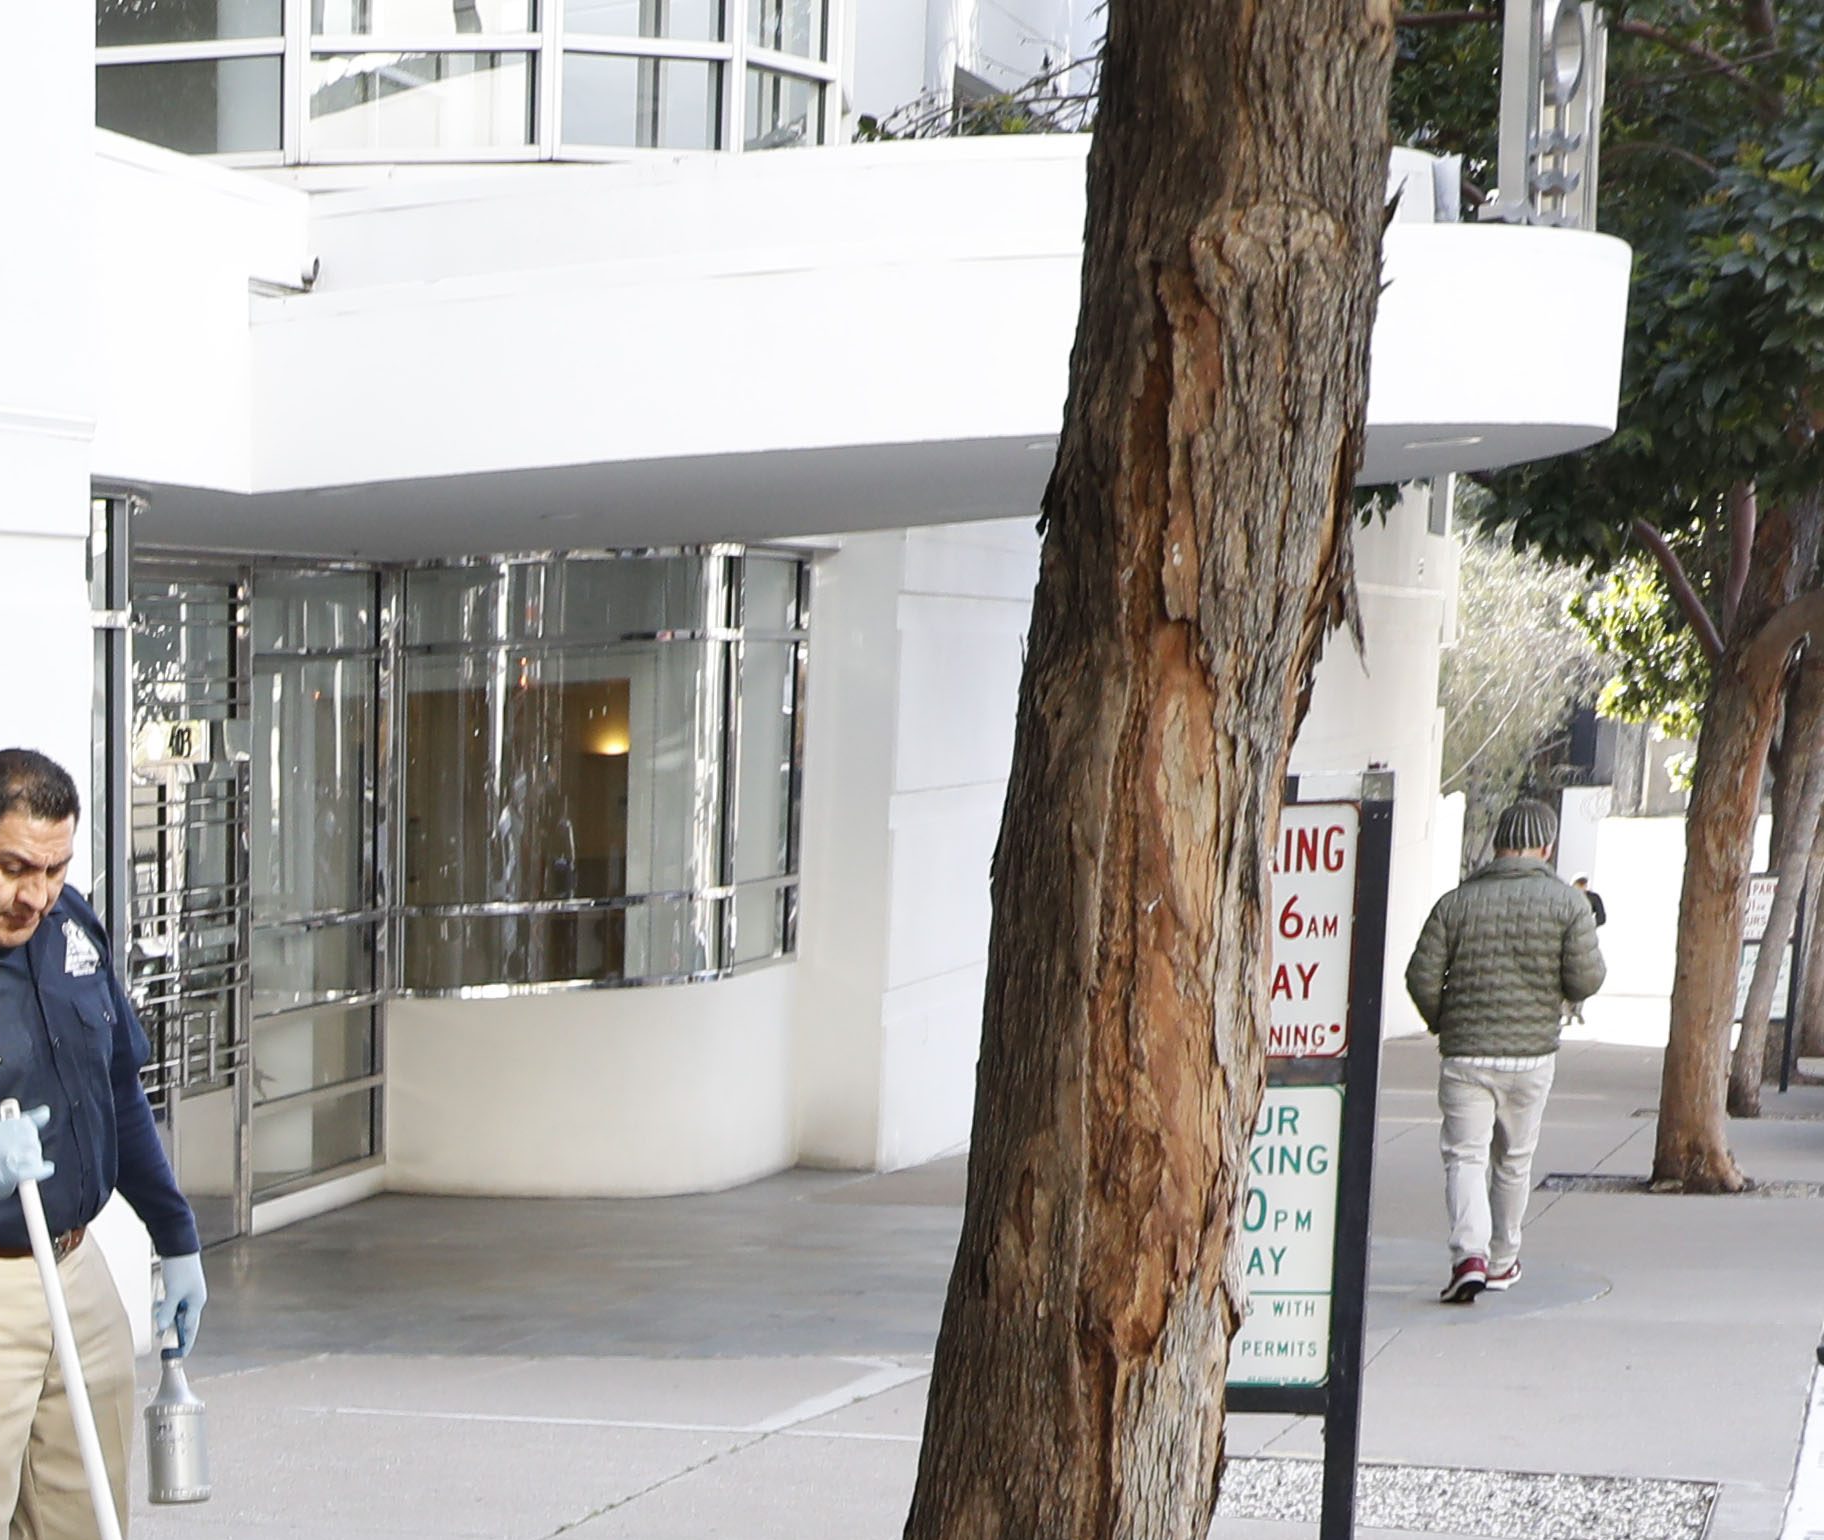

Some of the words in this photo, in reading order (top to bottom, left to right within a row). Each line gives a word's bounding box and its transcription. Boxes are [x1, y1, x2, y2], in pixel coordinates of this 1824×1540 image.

[1273, 826, 1345, 873] ING
[1272, 1301, 1316, 1317] WITH
[1241, 1341, 1318, 1358] PERMITS
